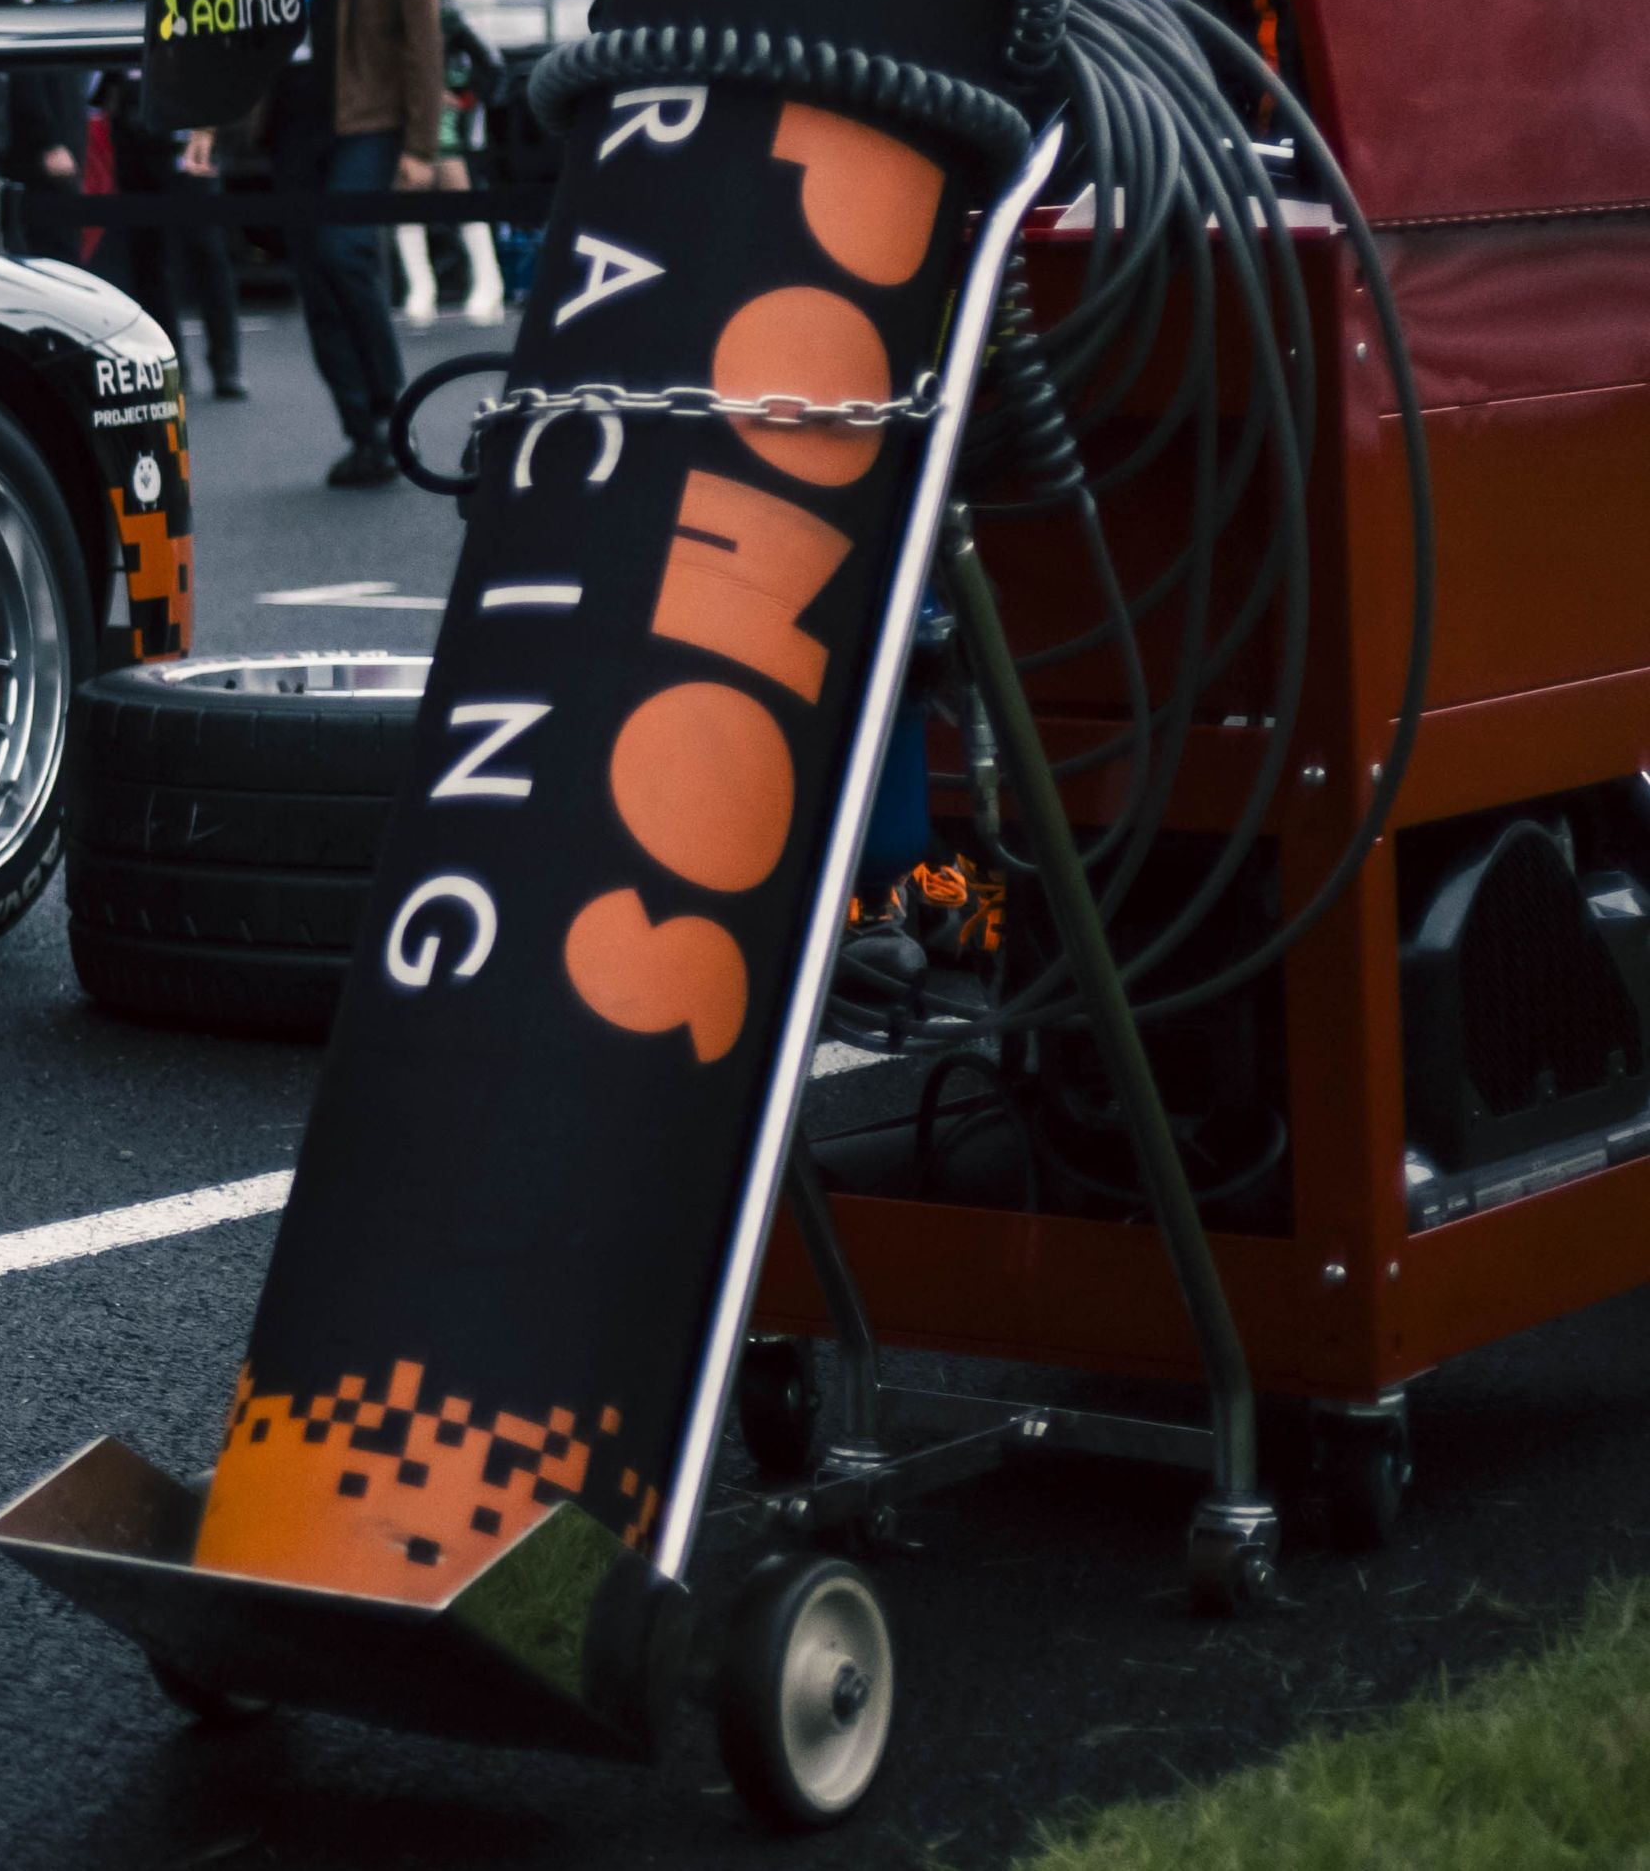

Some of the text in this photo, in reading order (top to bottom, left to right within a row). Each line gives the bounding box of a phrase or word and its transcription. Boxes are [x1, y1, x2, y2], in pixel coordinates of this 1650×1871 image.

[94, 405, 149, 427] PROJECT
[383, 83, 708, 988] RACING
[563, 100, 945, 1063] PONOS
